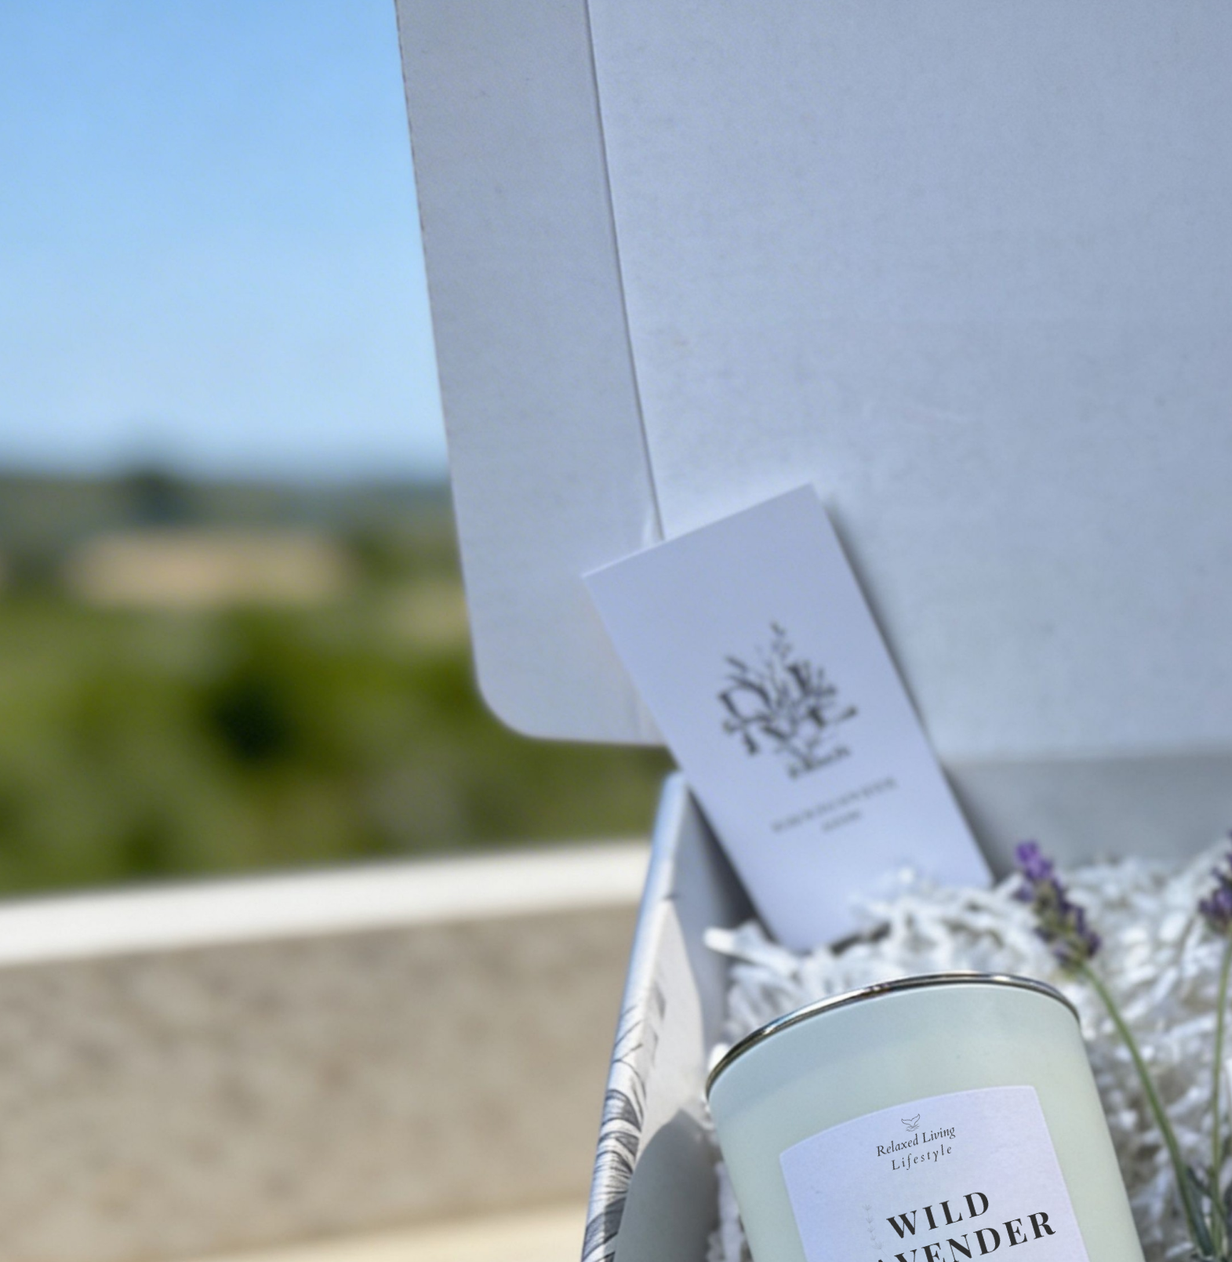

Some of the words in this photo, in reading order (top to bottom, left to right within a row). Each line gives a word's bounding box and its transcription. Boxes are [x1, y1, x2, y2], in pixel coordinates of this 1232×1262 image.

[876, 1132, 919, 1157] Relaxed
[922, 1126, 956, 1144] Living
[891, 1146, 952, 1170] Lifestyle
[886, 1191, 990, 1239] WILD
